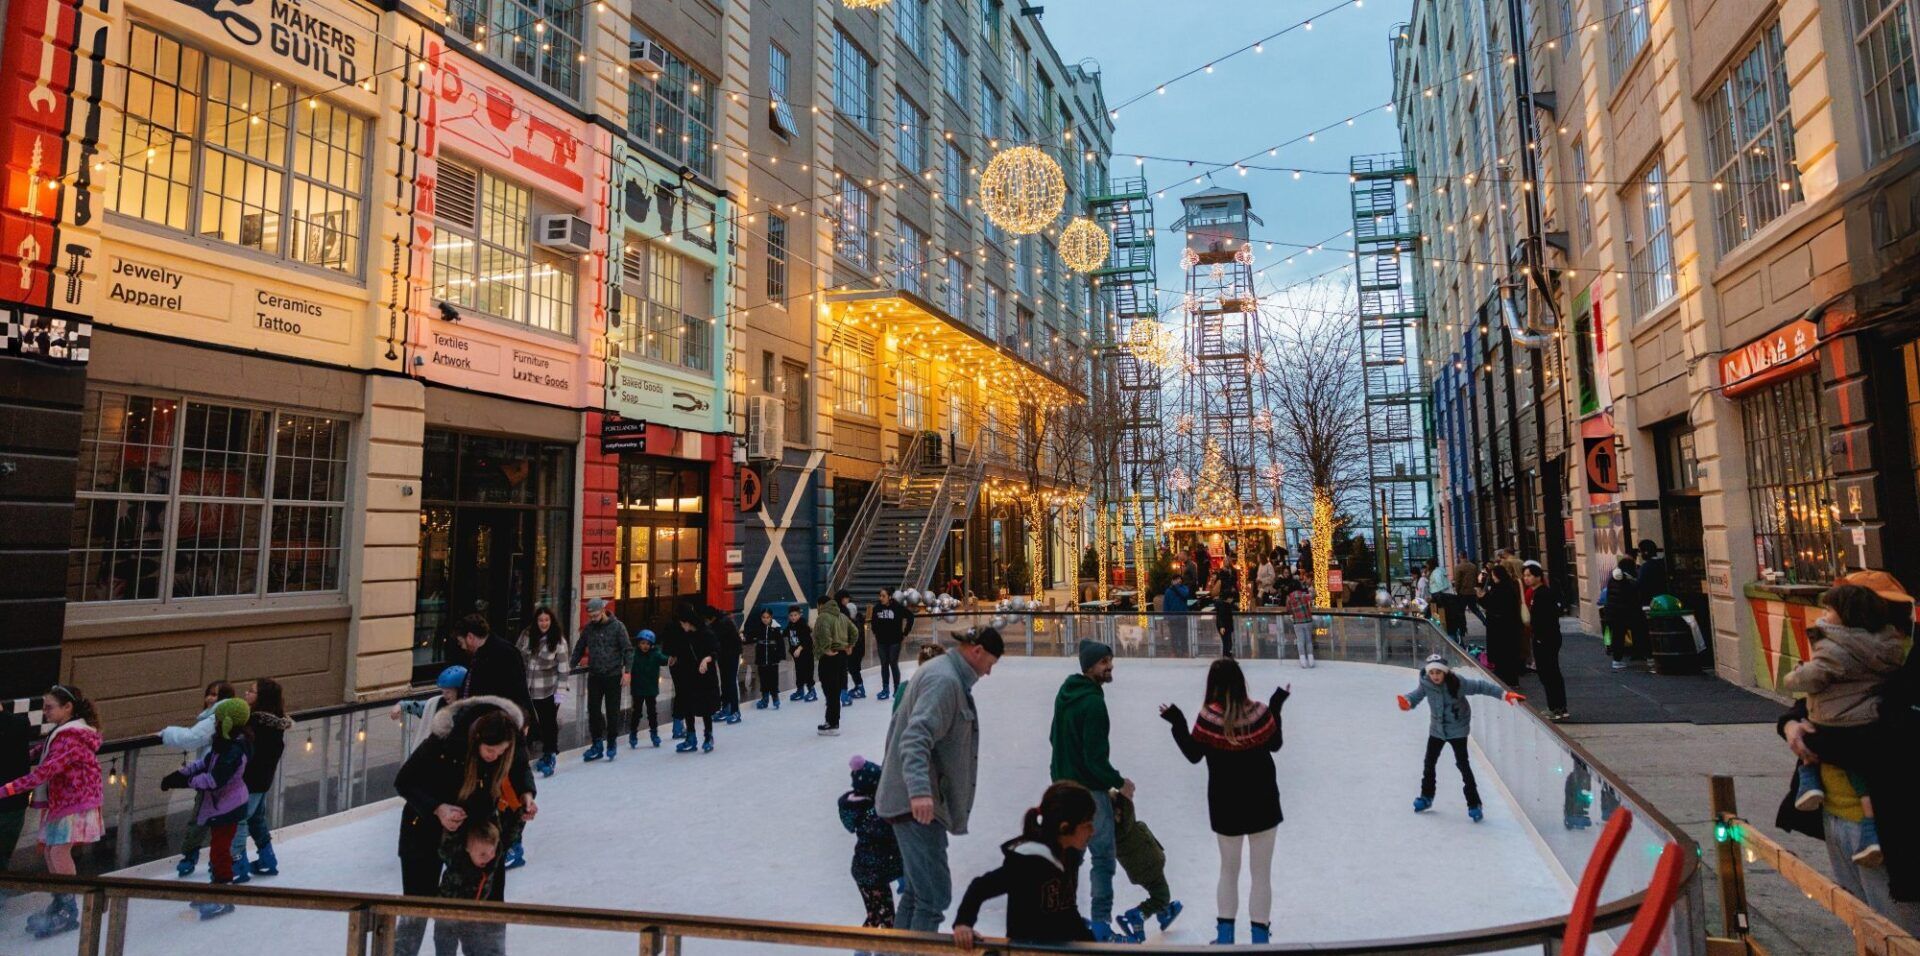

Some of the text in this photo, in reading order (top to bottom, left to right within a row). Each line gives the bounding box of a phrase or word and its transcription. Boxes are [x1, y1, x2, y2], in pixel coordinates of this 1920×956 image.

[271, 3, 356, 57] MAKERS
[270, 23, 356, 86] GUILD
[112, 259, 183, 289] Jewelry
[110, 283, 182, 310] Apparel
[257, 291, 322, 317] Ceramics
[256, 313, 301, 334] Tattoo
[433, 333, 469, 350] Textiles
[433, 352, 471, 368] Artwork
[513, 351, 549, 368] Furniture
[545, 374, 569, 389] Goods
[622, 376, 664, 393] Baked Goods
[621, 391, 639, 404] Soap
[592, 551, 610, 567] 5/6
